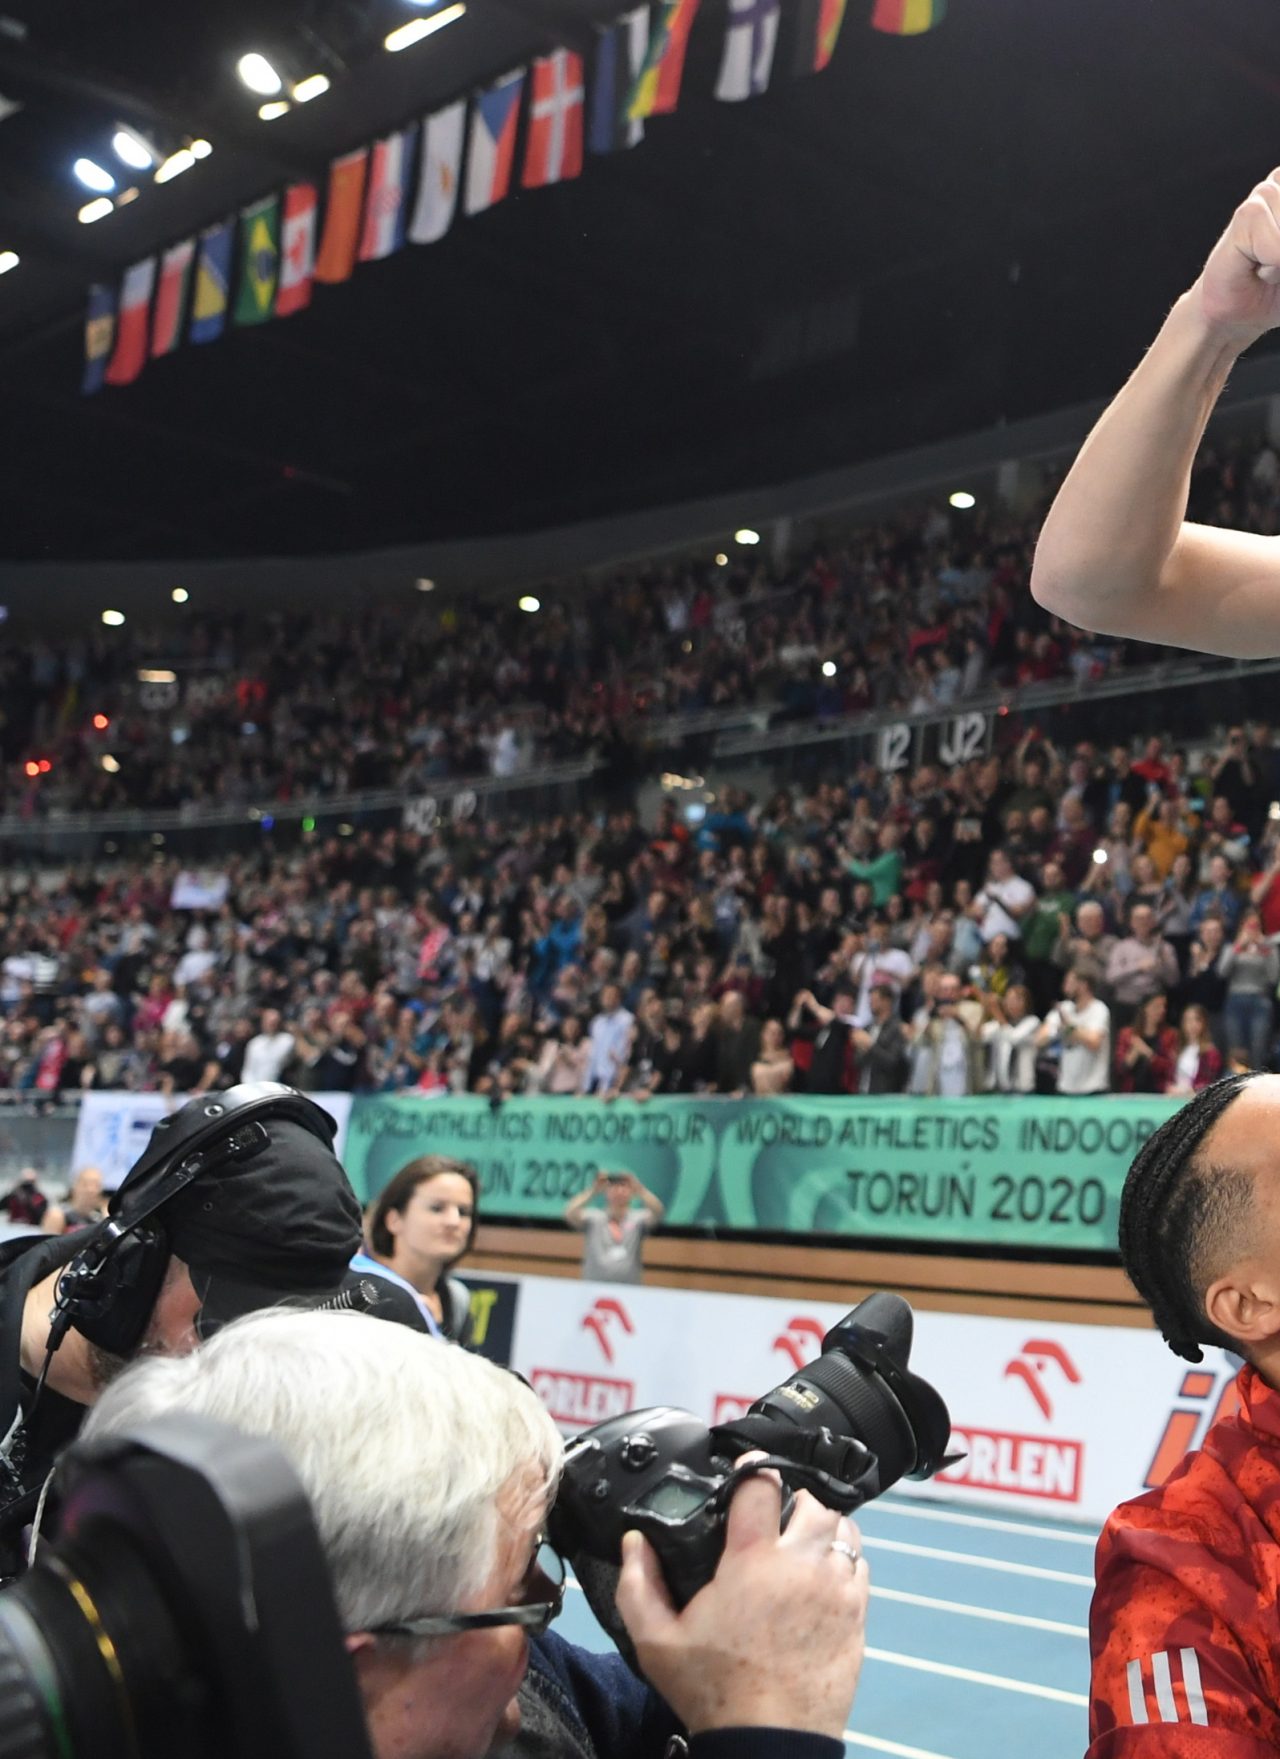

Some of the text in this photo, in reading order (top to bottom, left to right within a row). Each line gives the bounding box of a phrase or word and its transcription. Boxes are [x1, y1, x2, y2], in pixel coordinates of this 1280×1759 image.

[546, 1114, 633, 1143] INDOOR
[638, 1113, 706, 1144] TOUR
[736, 1113, 833, 1148] WORLD
[839, 1115, 1000, 1151] ATHLETICS
[846, 1161, 1107, 1225] TORUŃ 2020
[943, 1431, 1077, 1497] ORLEN
